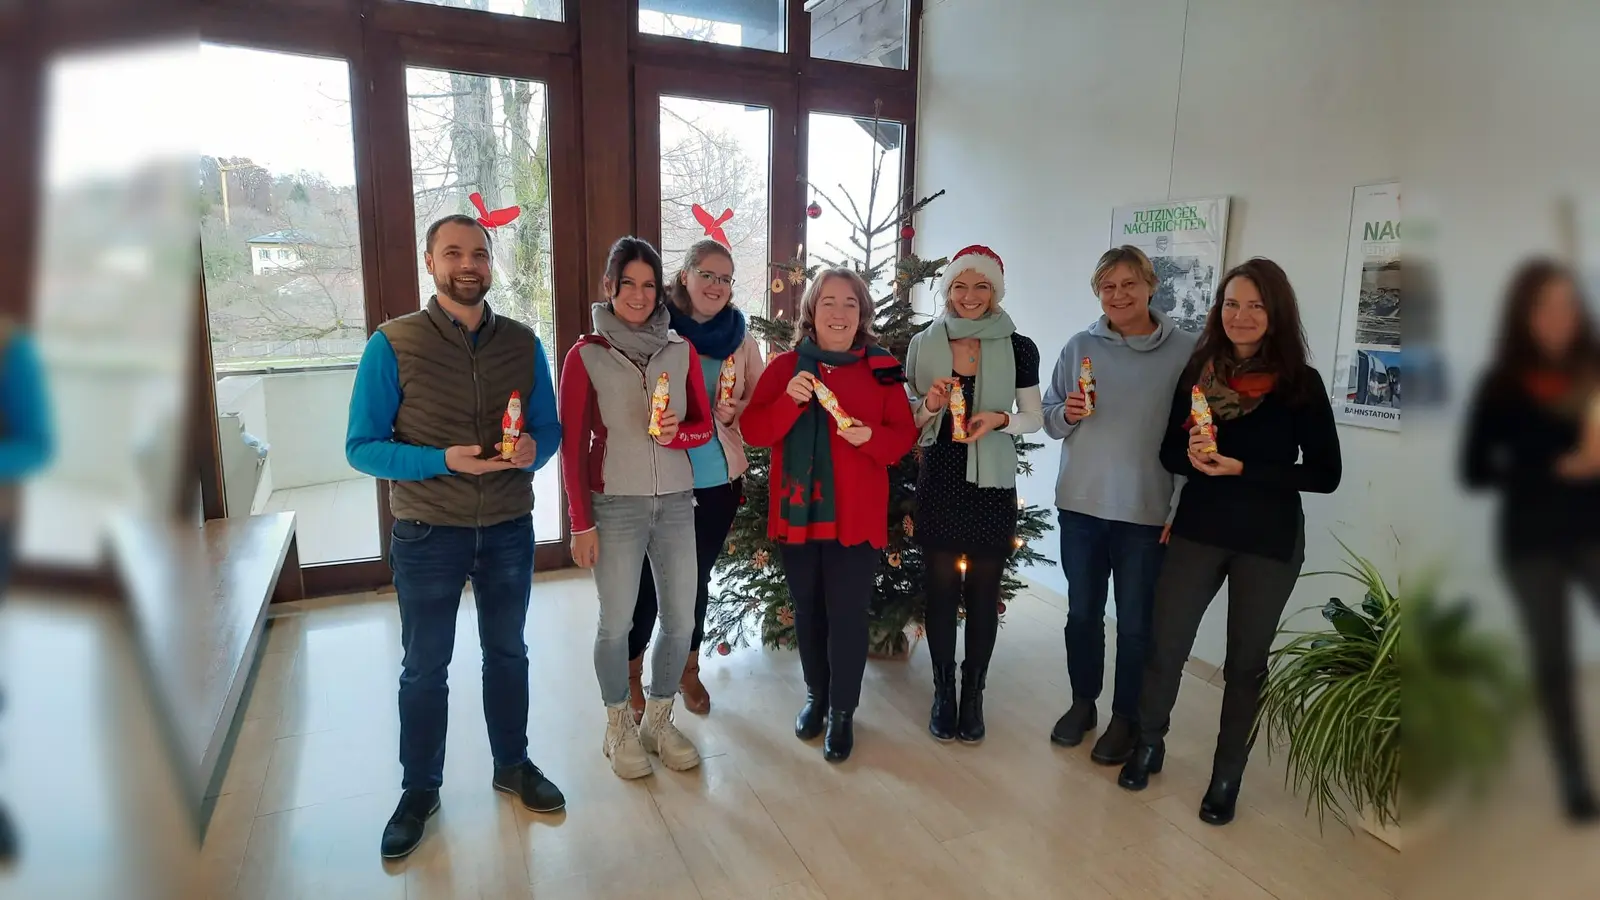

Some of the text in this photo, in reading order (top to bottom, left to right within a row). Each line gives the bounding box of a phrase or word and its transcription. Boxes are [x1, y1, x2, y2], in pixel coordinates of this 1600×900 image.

[1133, 206, 1197, 222] TUTZINGER
[1123, 217, 1207, 234] NACHRICHTEN
[1344, 407, 1395, 420] BAHNSTATION
